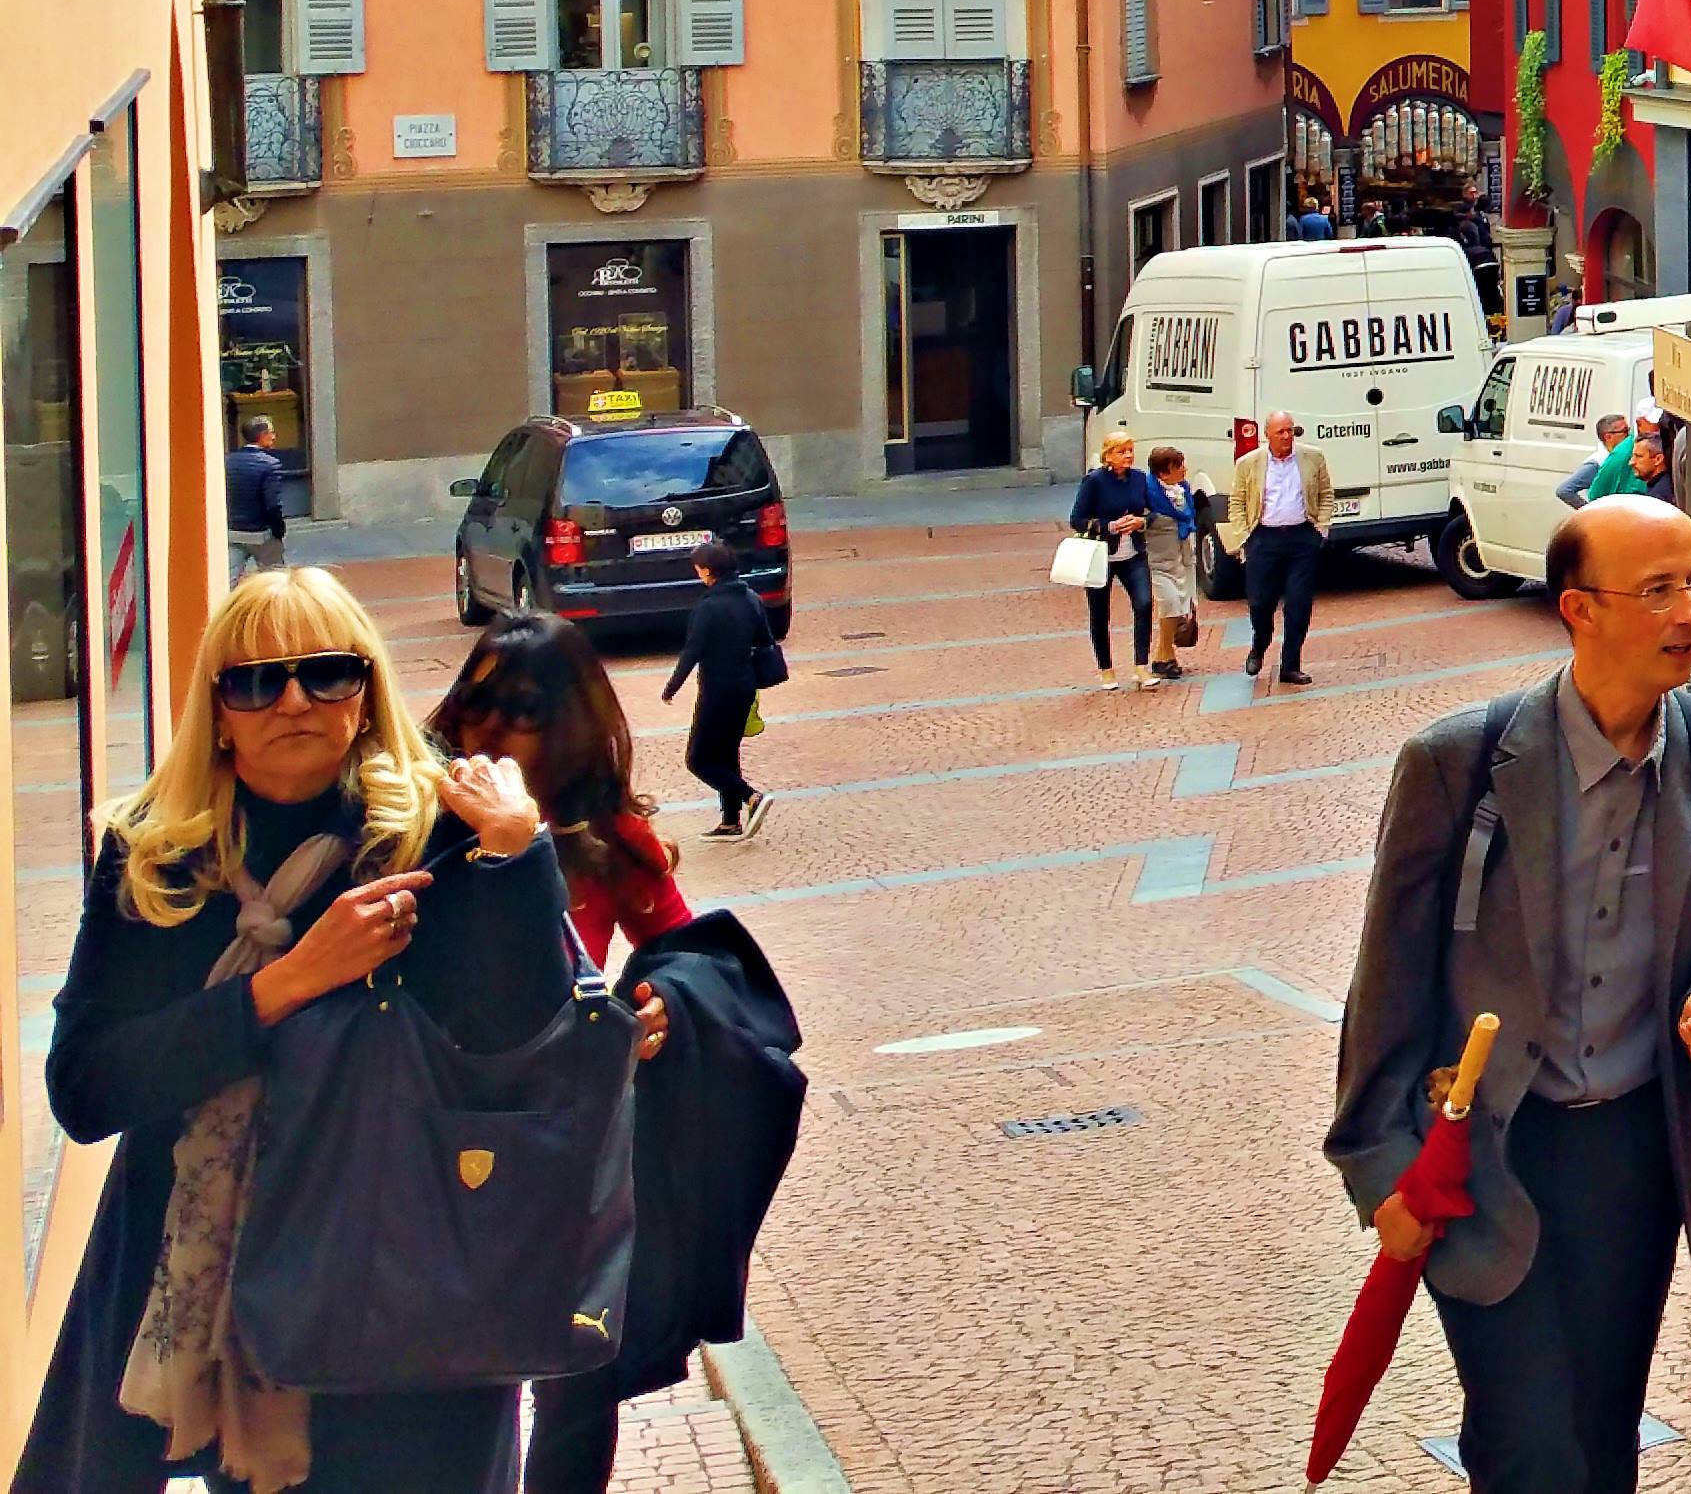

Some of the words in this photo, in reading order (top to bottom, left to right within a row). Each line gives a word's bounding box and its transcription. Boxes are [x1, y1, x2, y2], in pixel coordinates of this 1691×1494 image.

[1369, 60, 1469, 104] SALUMERIA
[947, 214, 985, 224] PARINI
[1154, 317, 1219, 380] GABBANI
[1289, 312, 1452, 364] GABBANI
[607, 393, 637, 403] TAXI
[1529, 364, 1594, 419] GABBANI
[1317, 421, 1372, 440] Catering
